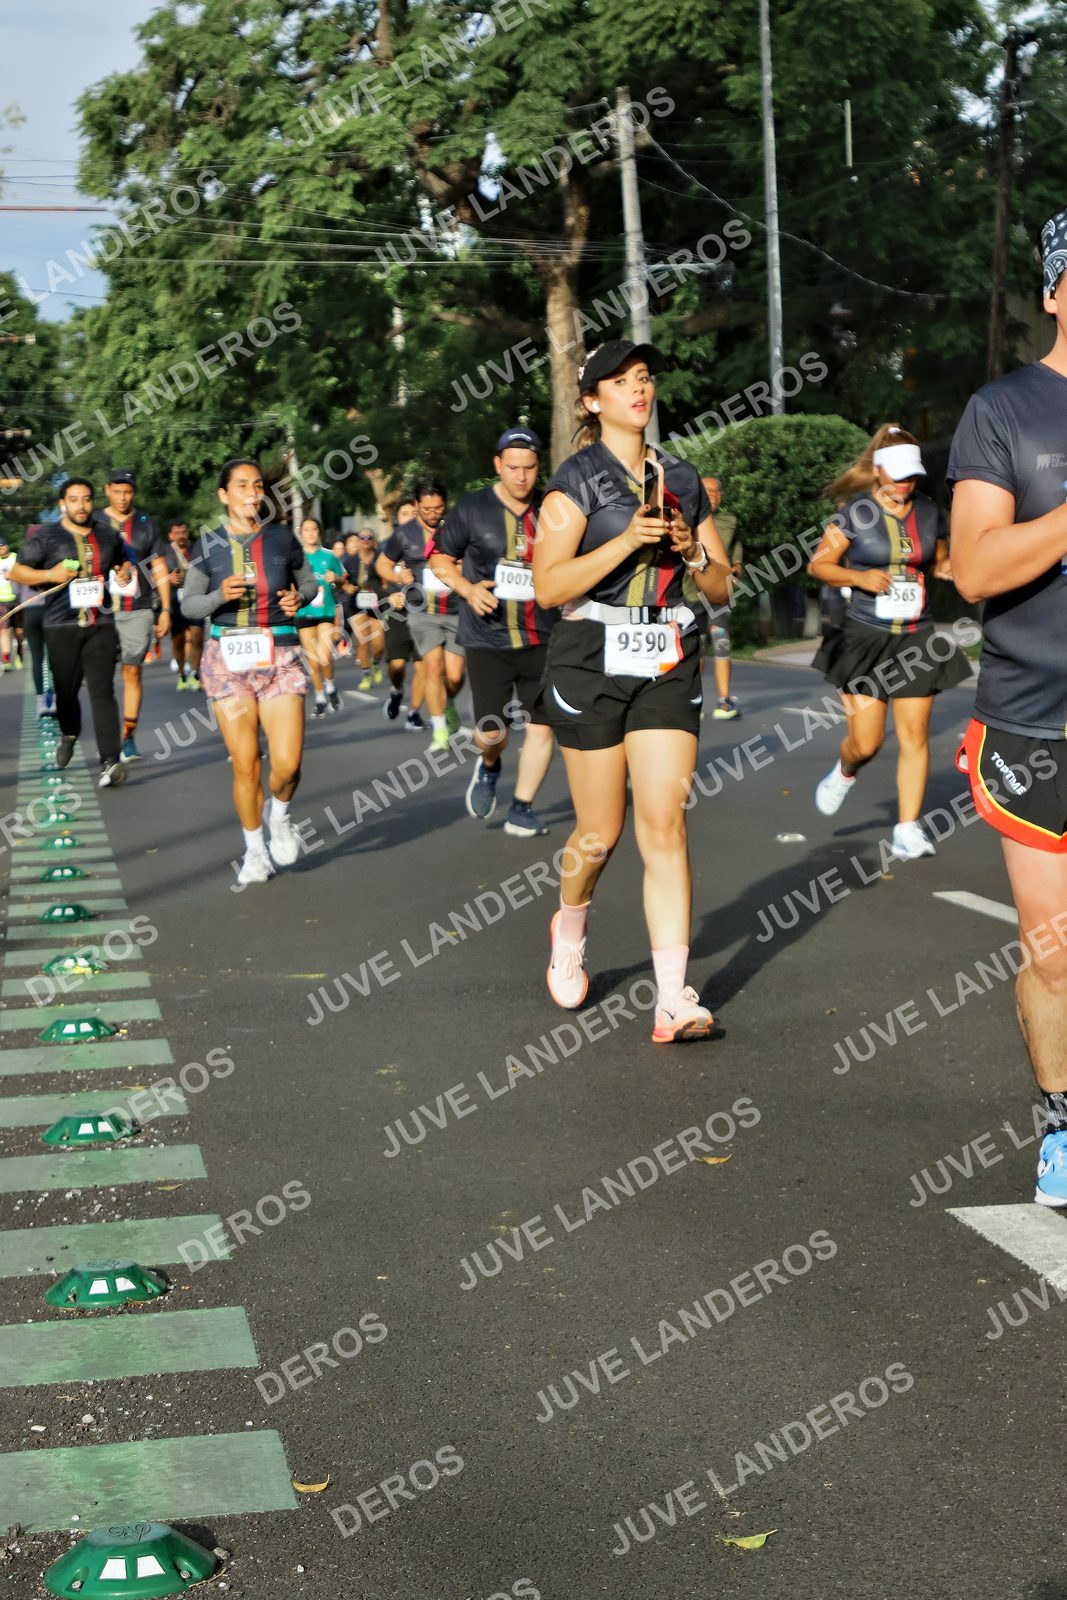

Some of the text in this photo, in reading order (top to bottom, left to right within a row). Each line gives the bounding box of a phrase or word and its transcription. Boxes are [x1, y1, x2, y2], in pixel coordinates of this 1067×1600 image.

[501, 571, 533, 587] 1007
[228, 641, 261, 655] 9281
[618, 631, 666, 653] 9590
[991, 751, 1027, 796] TOPTIME
